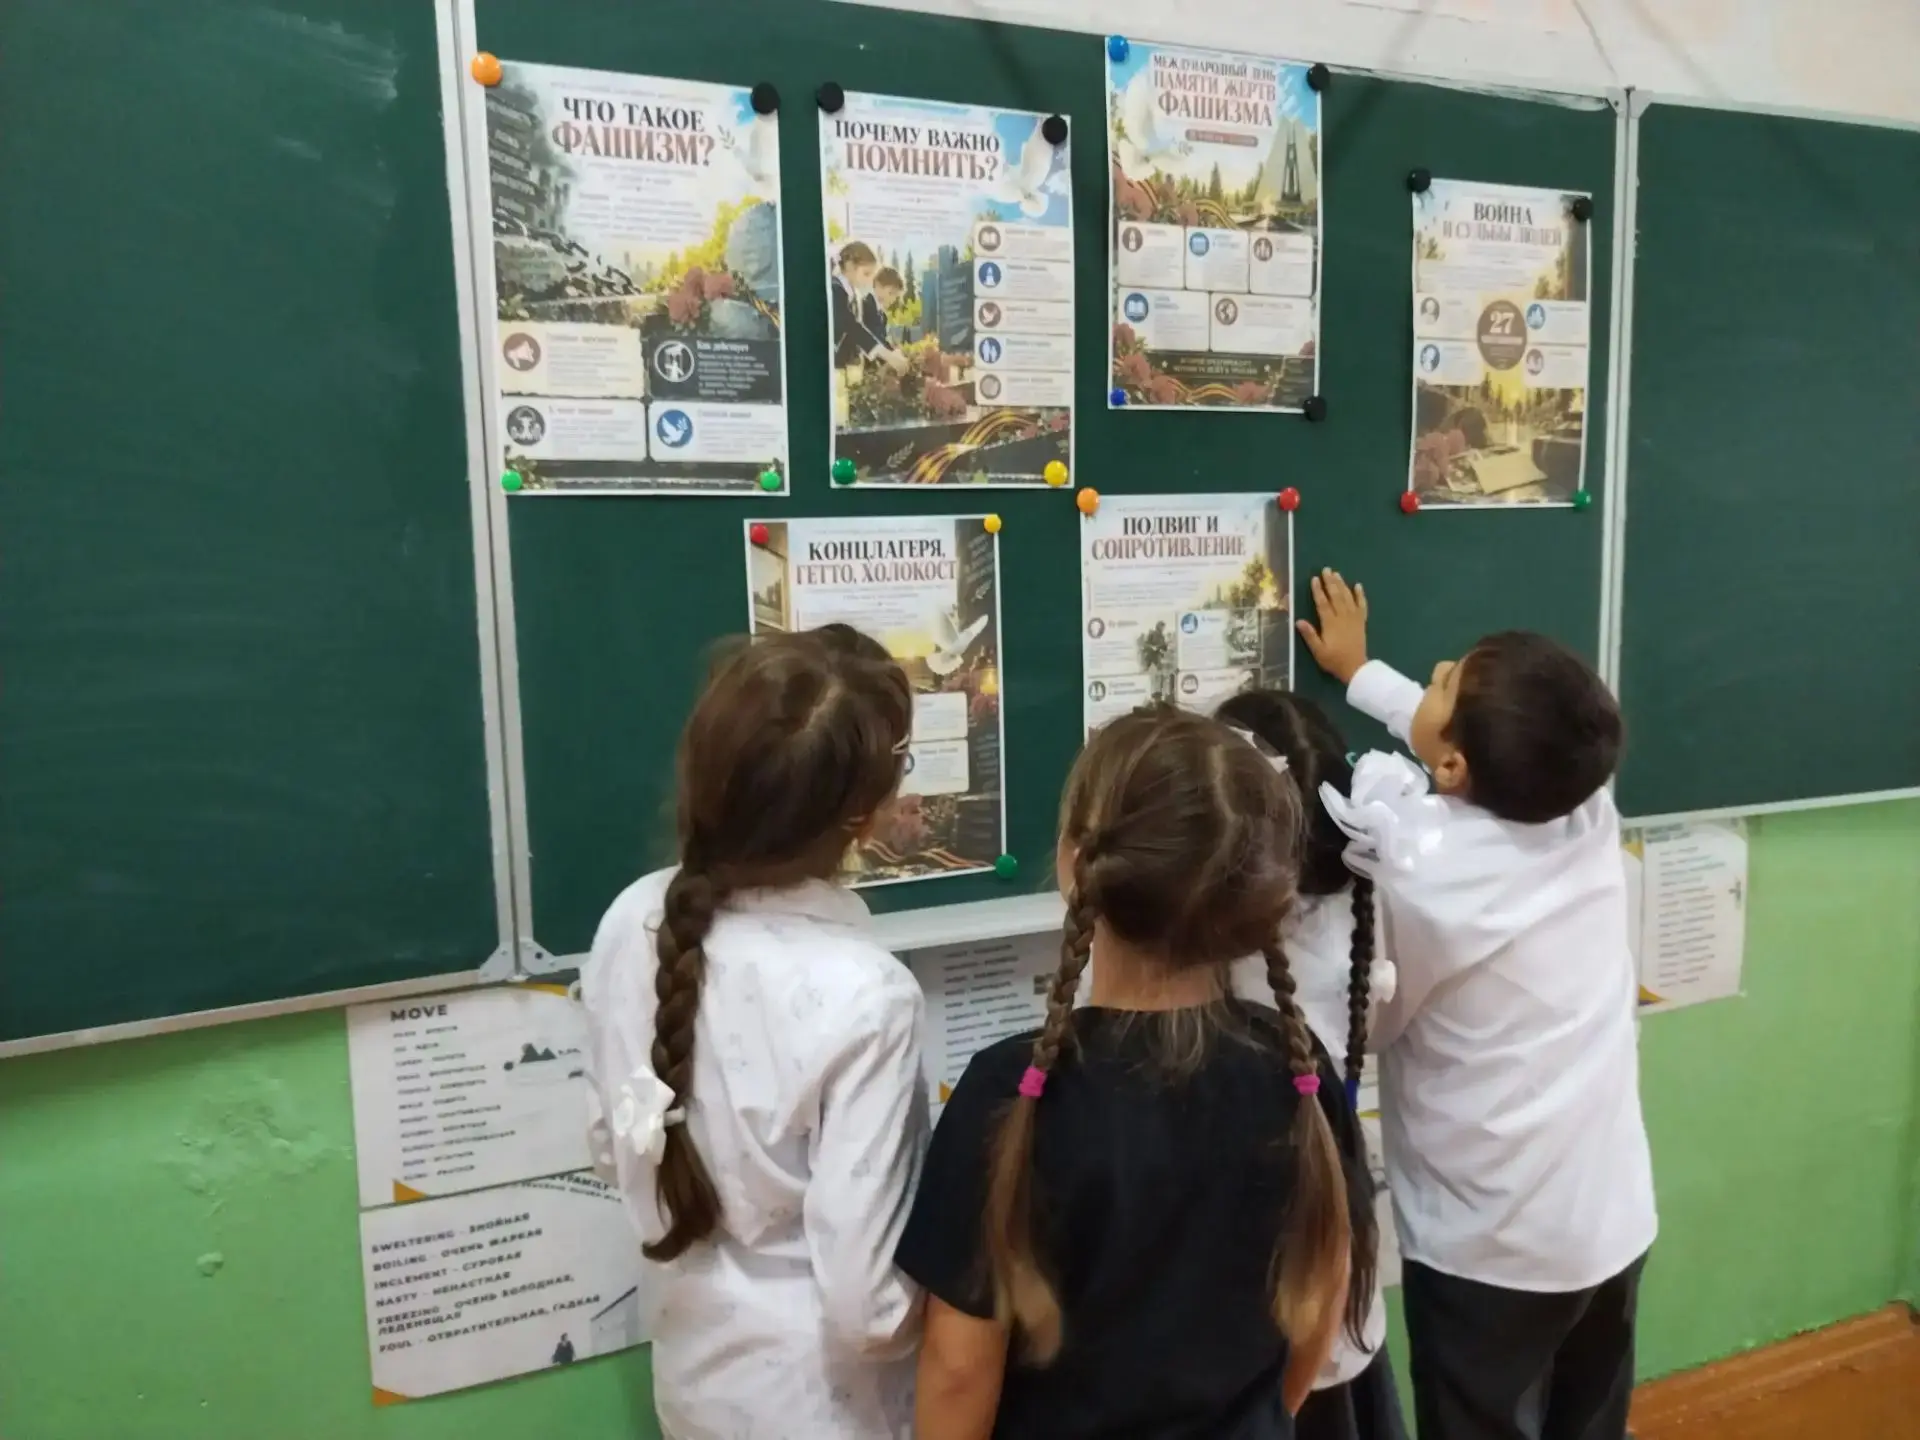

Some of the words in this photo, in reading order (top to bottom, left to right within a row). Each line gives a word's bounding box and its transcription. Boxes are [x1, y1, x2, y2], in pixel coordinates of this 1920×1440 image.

[1153, 55, 1248, 78] МЕЖДУНАРОДНЫЙ
[1153, 70, 1219, 95] ПАМЯТИ
[1223, 81, 1276, 100] ЖЕРТВ
[563, 97, 615, 123] ЧТО
[622, 102, 705, 133] ТАКОЕ
[1158, 90, 1273, 127] ФАШИЗМА
[552, 120, 716, 167] ФАШИЗМ?
[835, 119, 921, 146] ПОЧЕМУ
[927, 129, 1000, 152] ВАЖНО
[845, 142, 999, 182] ПОМНИТЬ?
[1473, 201, 1533, 226] ВОЙНА
[1489, 310, 1515, 335] 27
[1122, 516, 1201, 537] ПОДВИГ
[1206, 515, 1219, 533] И
[808, 539, 947, 563] КОНЦЛАГЕРЯ,
[1091, 534, 1247, 561] СОПРОТИВЛЕНИЕ
[796, 563, 857, 586] ГЕТТО,
[861, 560, 958, 583] ХОЛОКОСТ
[390, 1003, 448, 1023] MOVE
[371, 1230, 456, 1254] SWELTERING
[469, 1212, 531, 1234] ЗНОЙНАЯ
[372, 1254, 428, 1272] BOILING
[441, 1243, 484, 1258] ОЧЕНЬ
[374, 1268, 448, 1290] INCLEMENT
[462, 1251, 523, 1271] СУРОВАЯ
[375, 1291, 418, 1308] NASTY
[432, 1271, 512, 1296] НЕНАСТНАЯ
[377, 1305, 441, 1325] FREEZING
[454, 1293, 498, 1309] ОЧЕНЬ
[379, 1340, 413, 1354] FOUL
